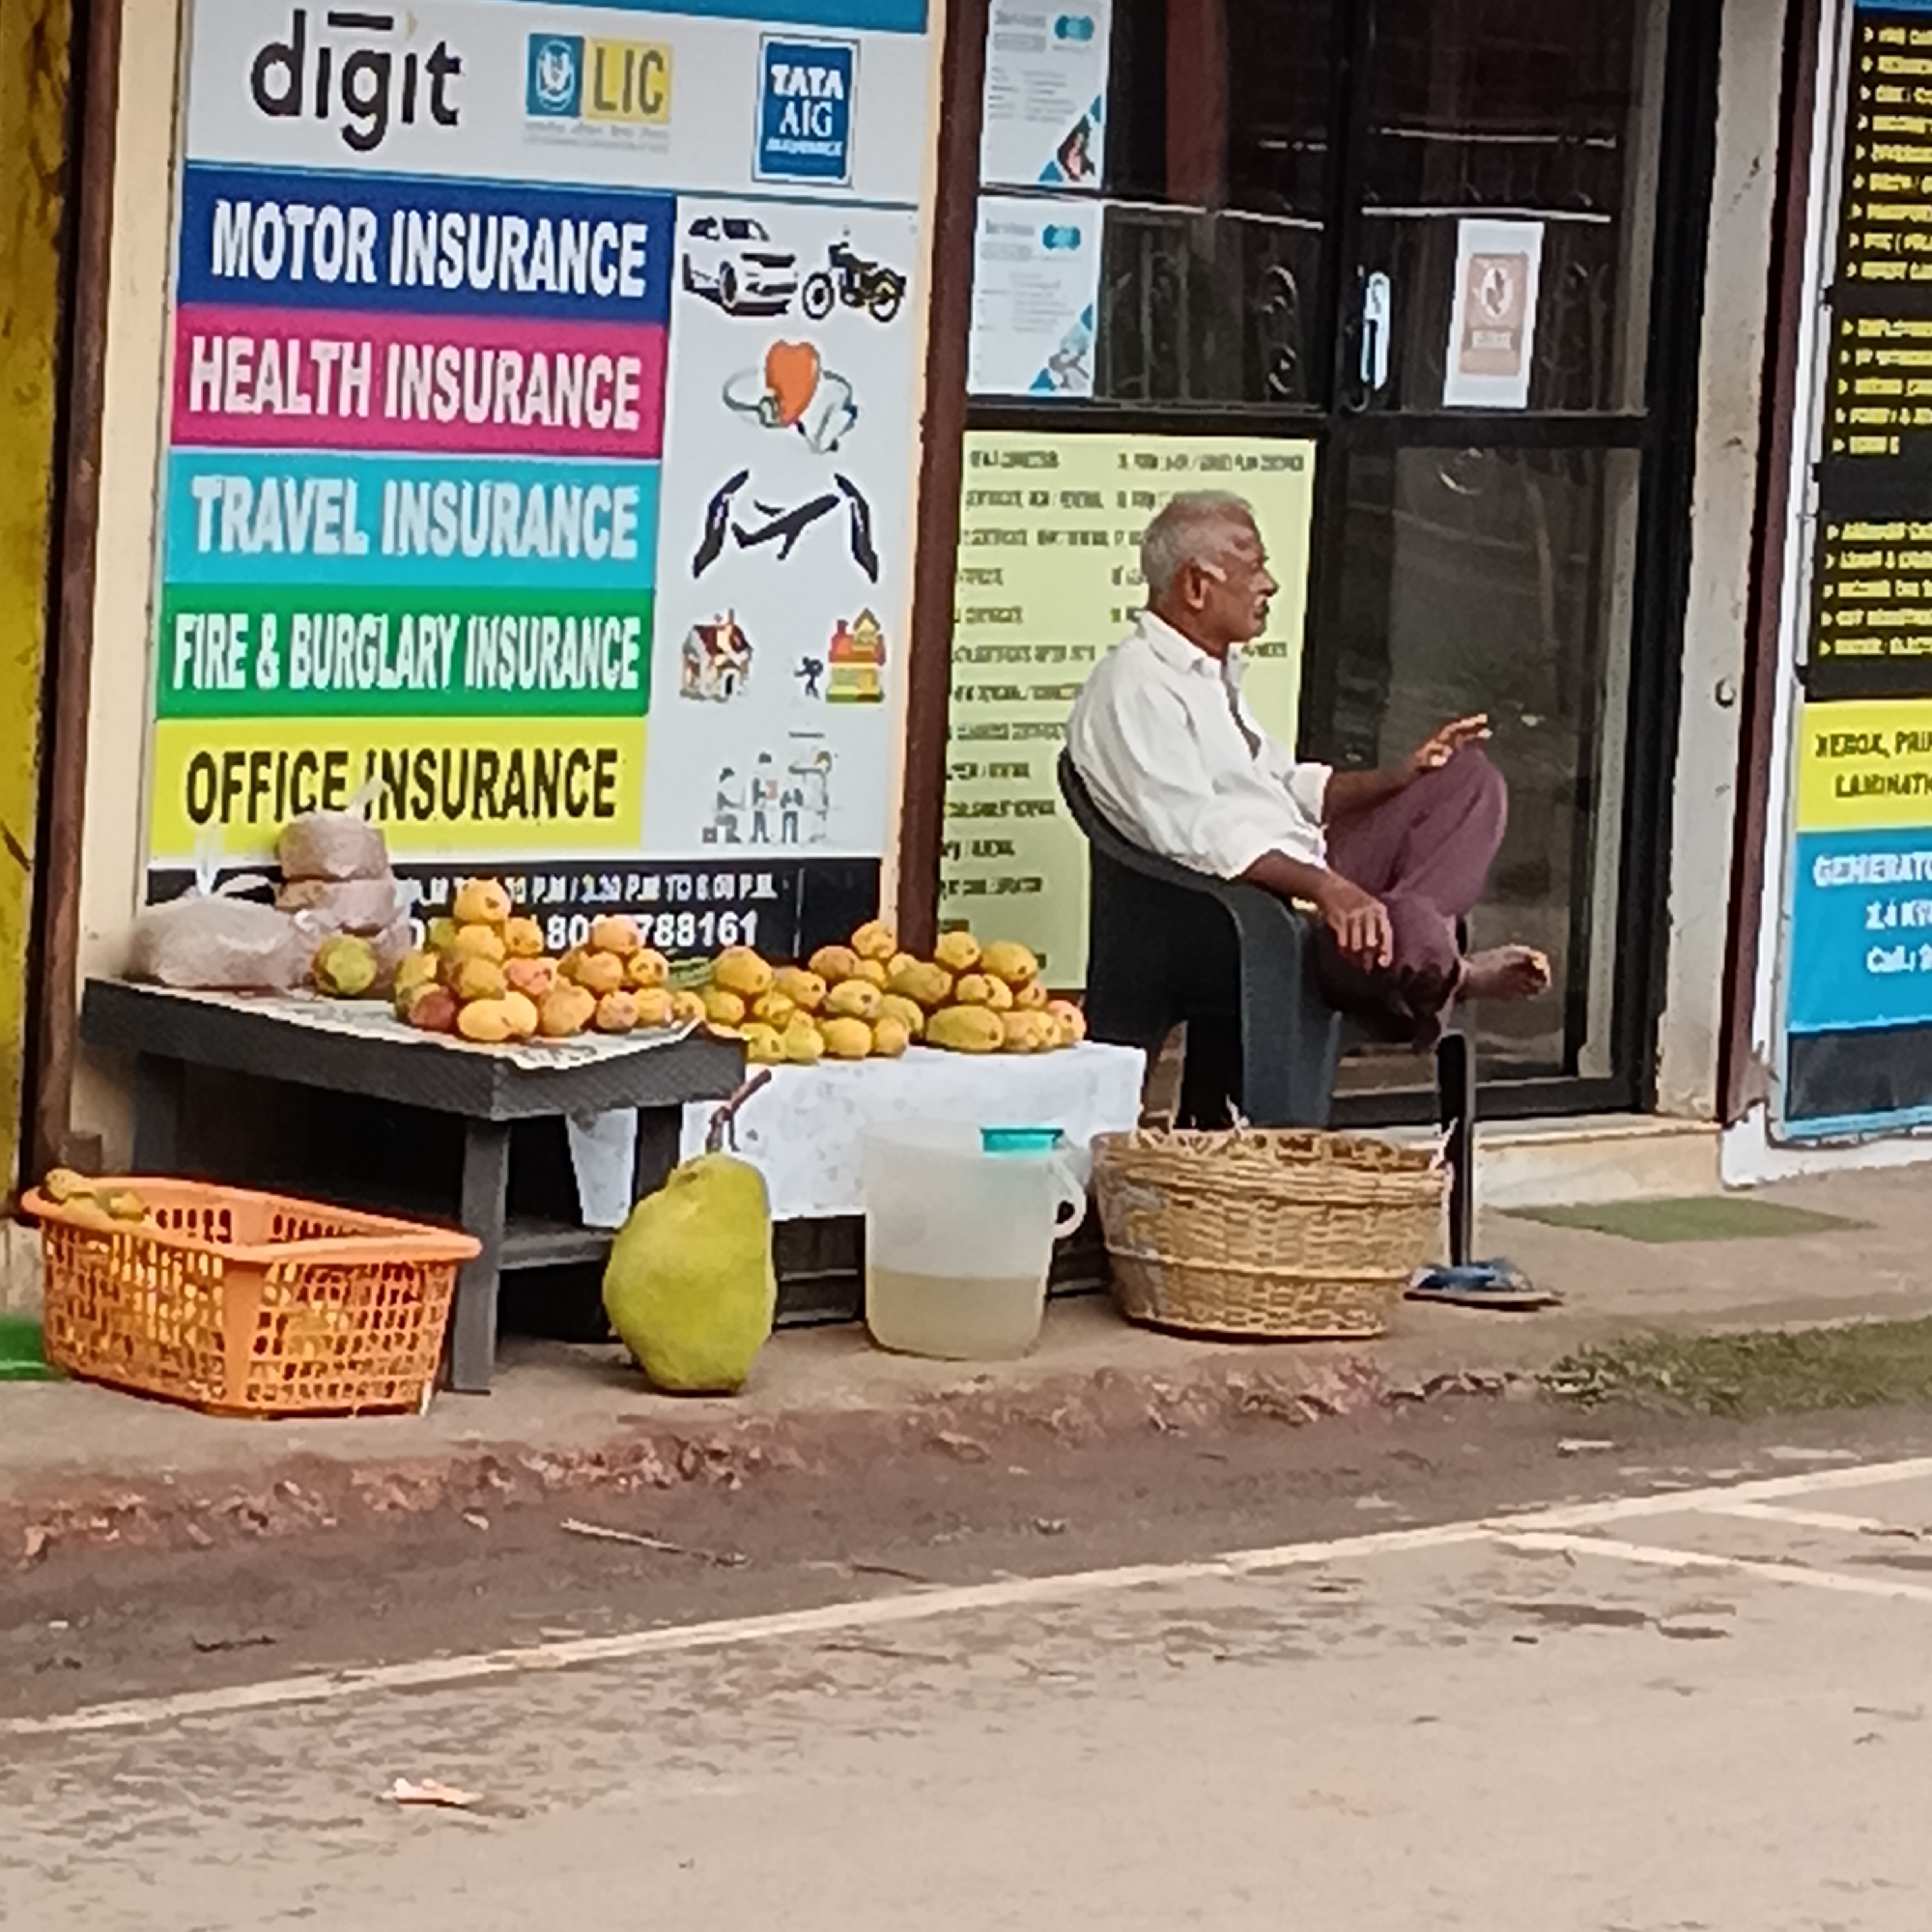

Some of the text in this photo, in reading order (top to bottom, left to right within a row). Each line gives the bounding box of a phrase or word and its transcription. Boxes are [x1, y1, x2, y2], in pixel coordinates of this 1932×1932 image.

[250, 8, 464, 152] digit
[592, 46, 666, 116] LIC
[770, 64, 843, 100] TATA
[779, 100, 833, 137] AIG
[211, 199, 648, 298] MOTOR INSURANCE
[189, 335, 641, 431] HEALTH INSURANCE
[191, 474, 639, 560] TRAVEL INSURANCE
[172, 612, 640, 693] FIRE & BURGLARY INSURANCE
[185, 747, 618, 825] OFFICE INSURANCE
[666, 874, 692, 901] TO
